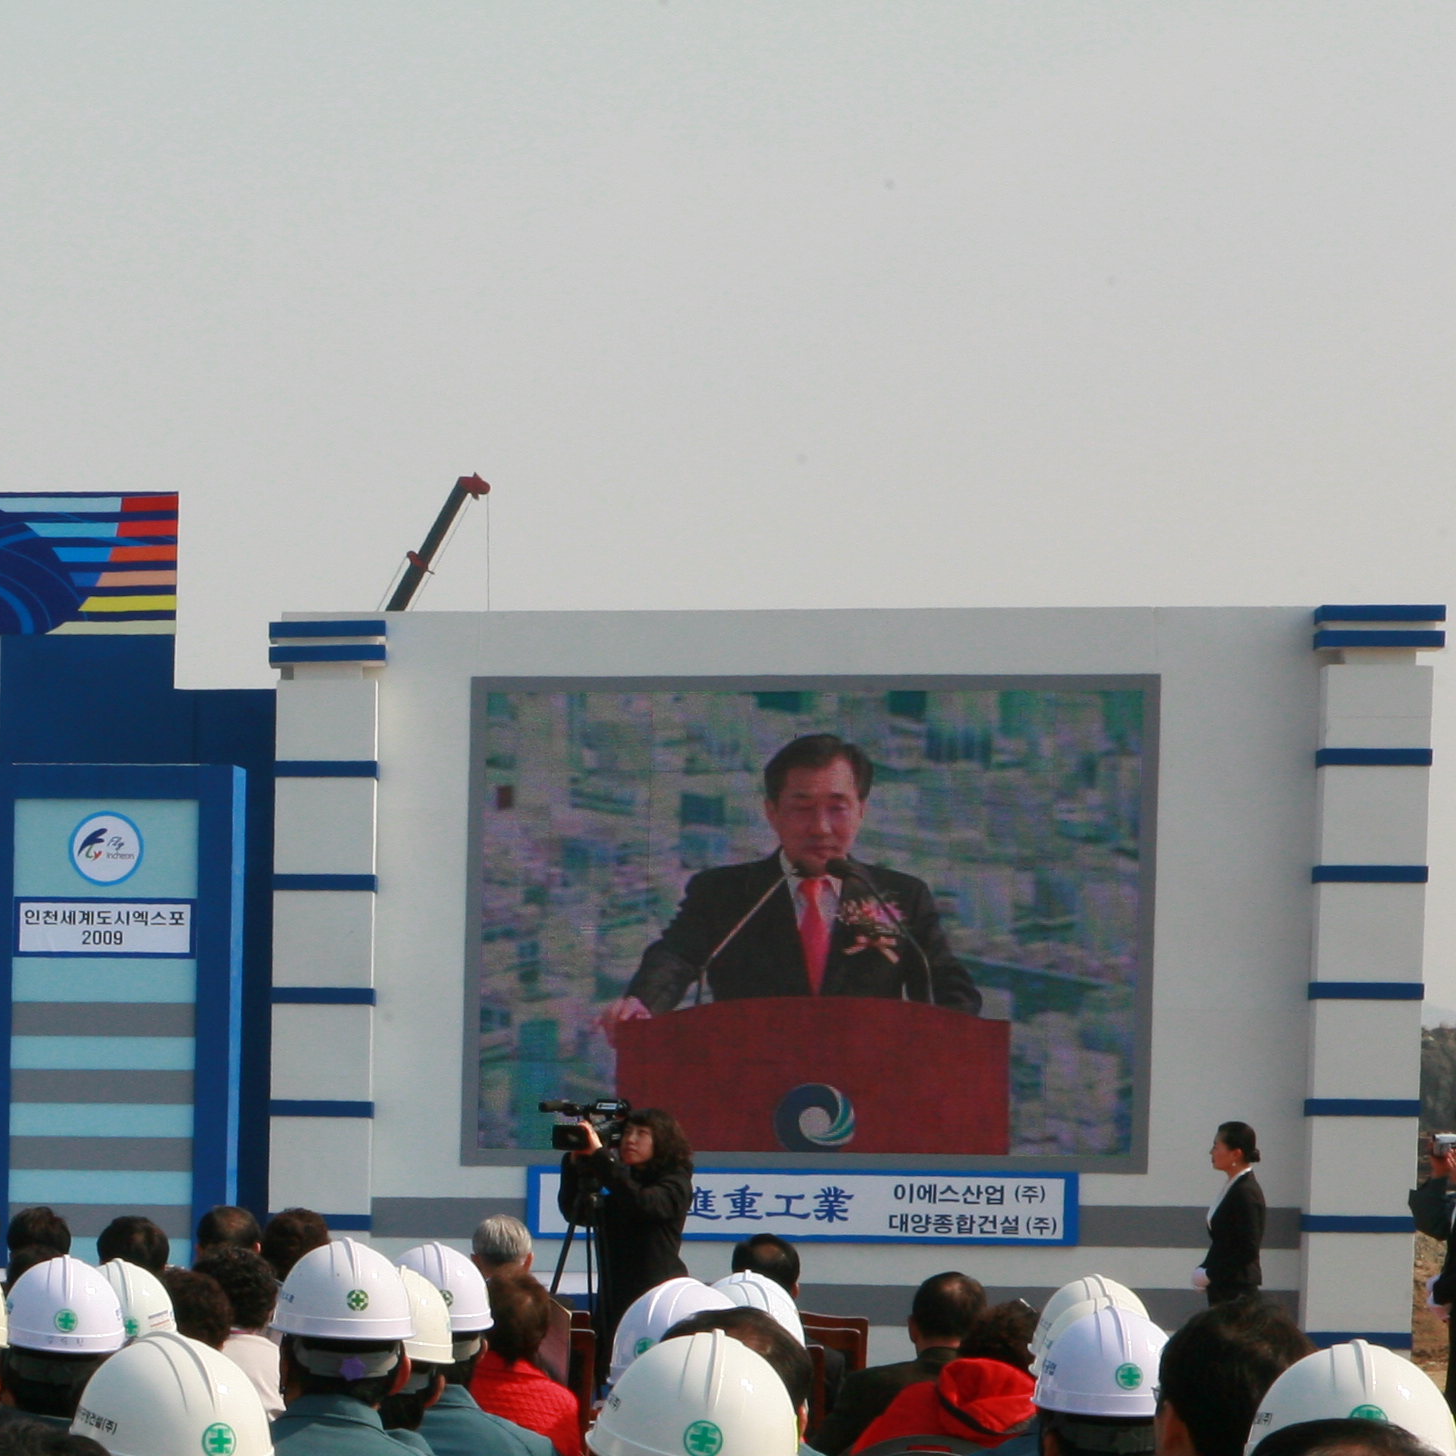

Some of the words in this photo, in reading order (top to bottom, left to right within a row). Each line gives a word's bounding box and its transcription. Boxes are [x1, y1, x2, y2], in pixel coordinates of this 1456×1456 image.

[24, 909, 186, 927] 인천세계도시엑스포
[81, 930, 124, 946] 2009
[893, 1183, 1005, 1206] 이에스산업
[1014, 1185, 1047, 1204] (주)
[888, 1213, 1019, 1236] 대양종합건설
[1025, 1216, 1058, 1236] (주)
